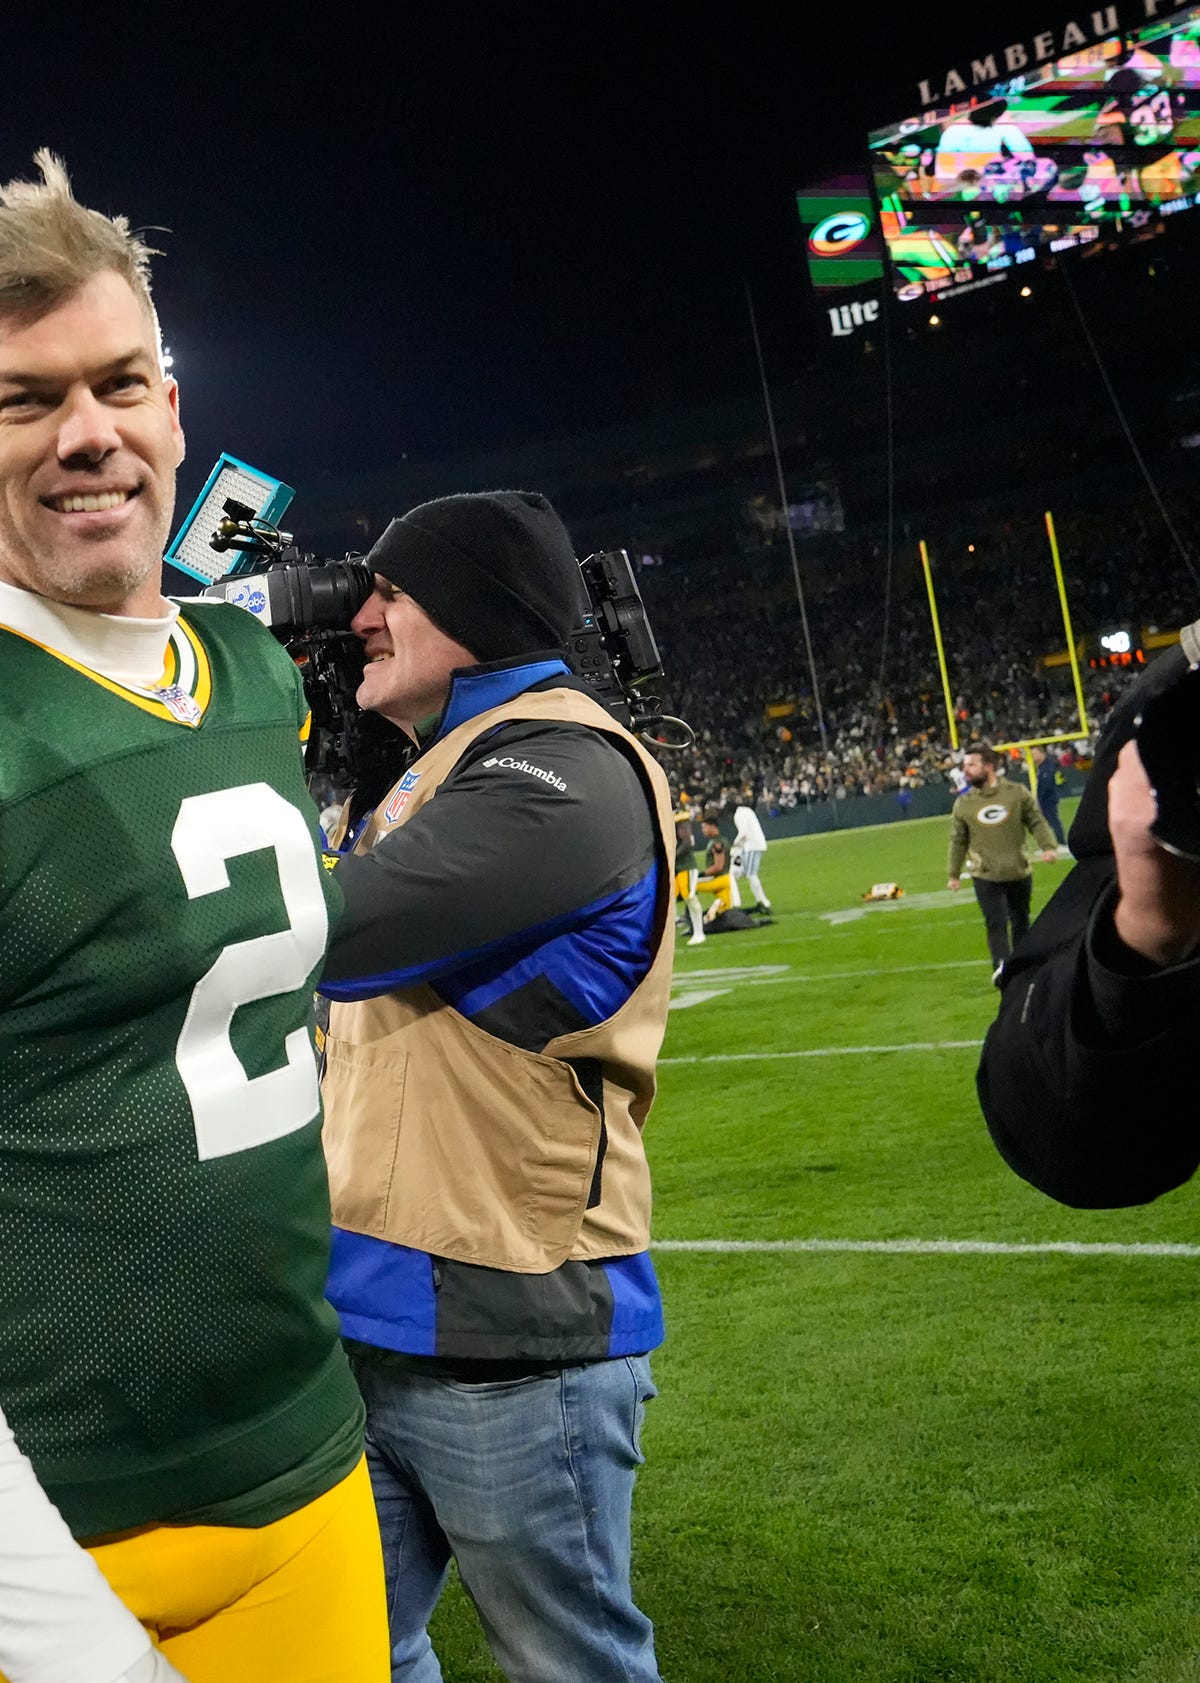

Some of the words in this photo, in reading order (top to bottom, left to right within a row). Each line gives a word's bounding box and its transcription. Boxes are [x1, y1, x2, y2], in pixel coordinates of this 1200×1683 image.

[917, 4, 1120, 106] LAMBEAU
[827, 299, 880, 337] Lite
[497, 757, 568, 792] Columbia
[170, 782, 328, 1161] 2
